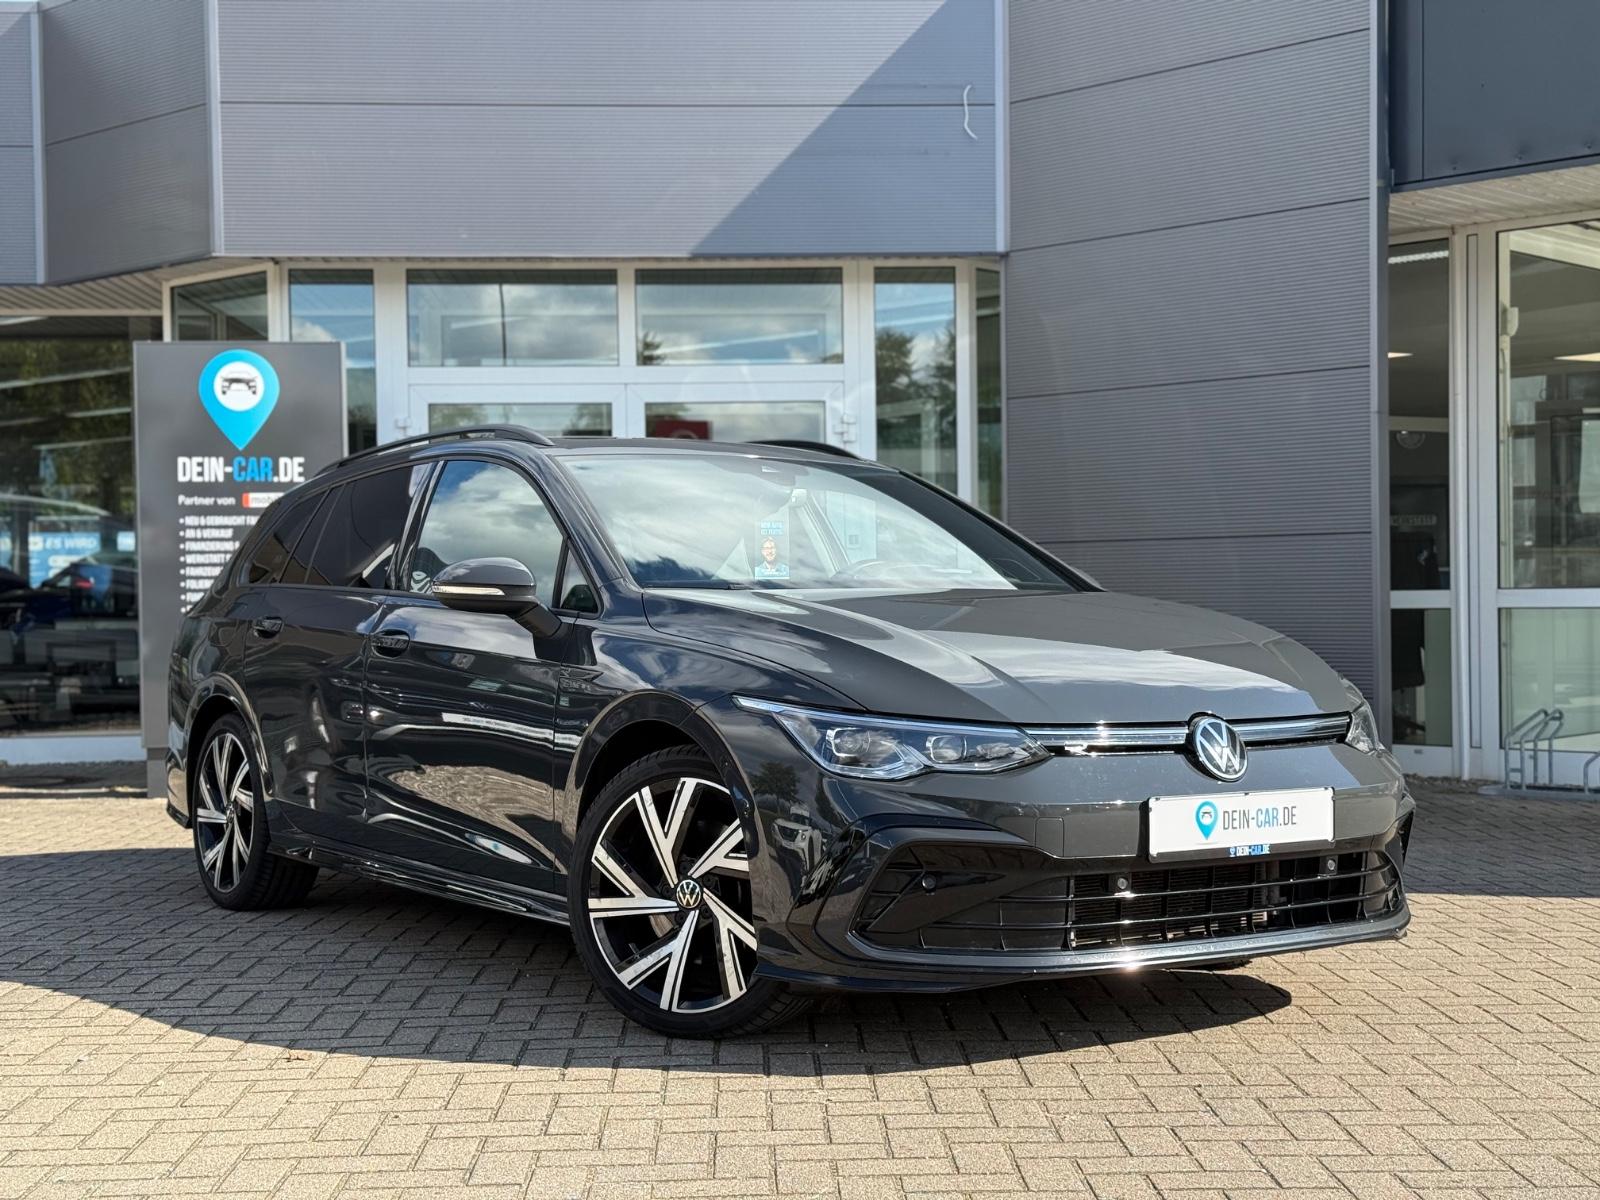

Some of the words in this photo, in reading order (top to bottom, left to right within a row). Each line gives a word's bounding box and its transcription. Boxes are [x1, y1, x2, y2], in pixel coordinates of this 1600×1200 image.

[177, 456, 305, 483] DEIN-CAR.DE
[178, 494, 215, 507] Partner
[216, 496, 236, 506] von
[1222, 806, 1297, 831] DEIN-CAR.DE
